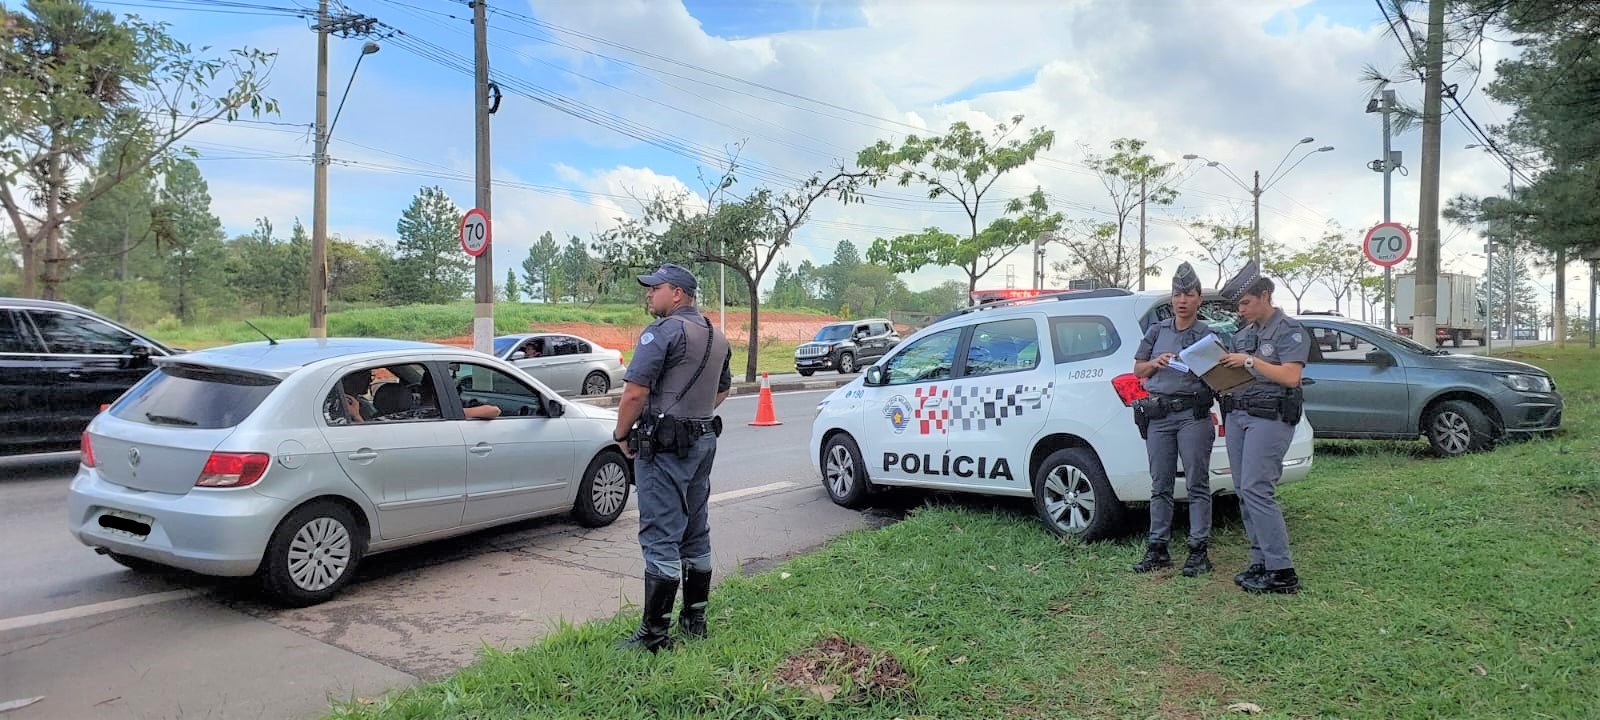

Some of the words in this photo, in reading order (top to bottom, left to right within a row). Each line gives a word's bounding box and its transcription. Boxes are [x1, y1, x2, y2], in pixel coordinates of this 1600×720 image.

[465, 222, 484, 241] 70
[1371, 235, 1402, 253] 70
[1068, 367, 1104, 380] I-08230
[883, 449, 1014, 481] POLÍCIA
